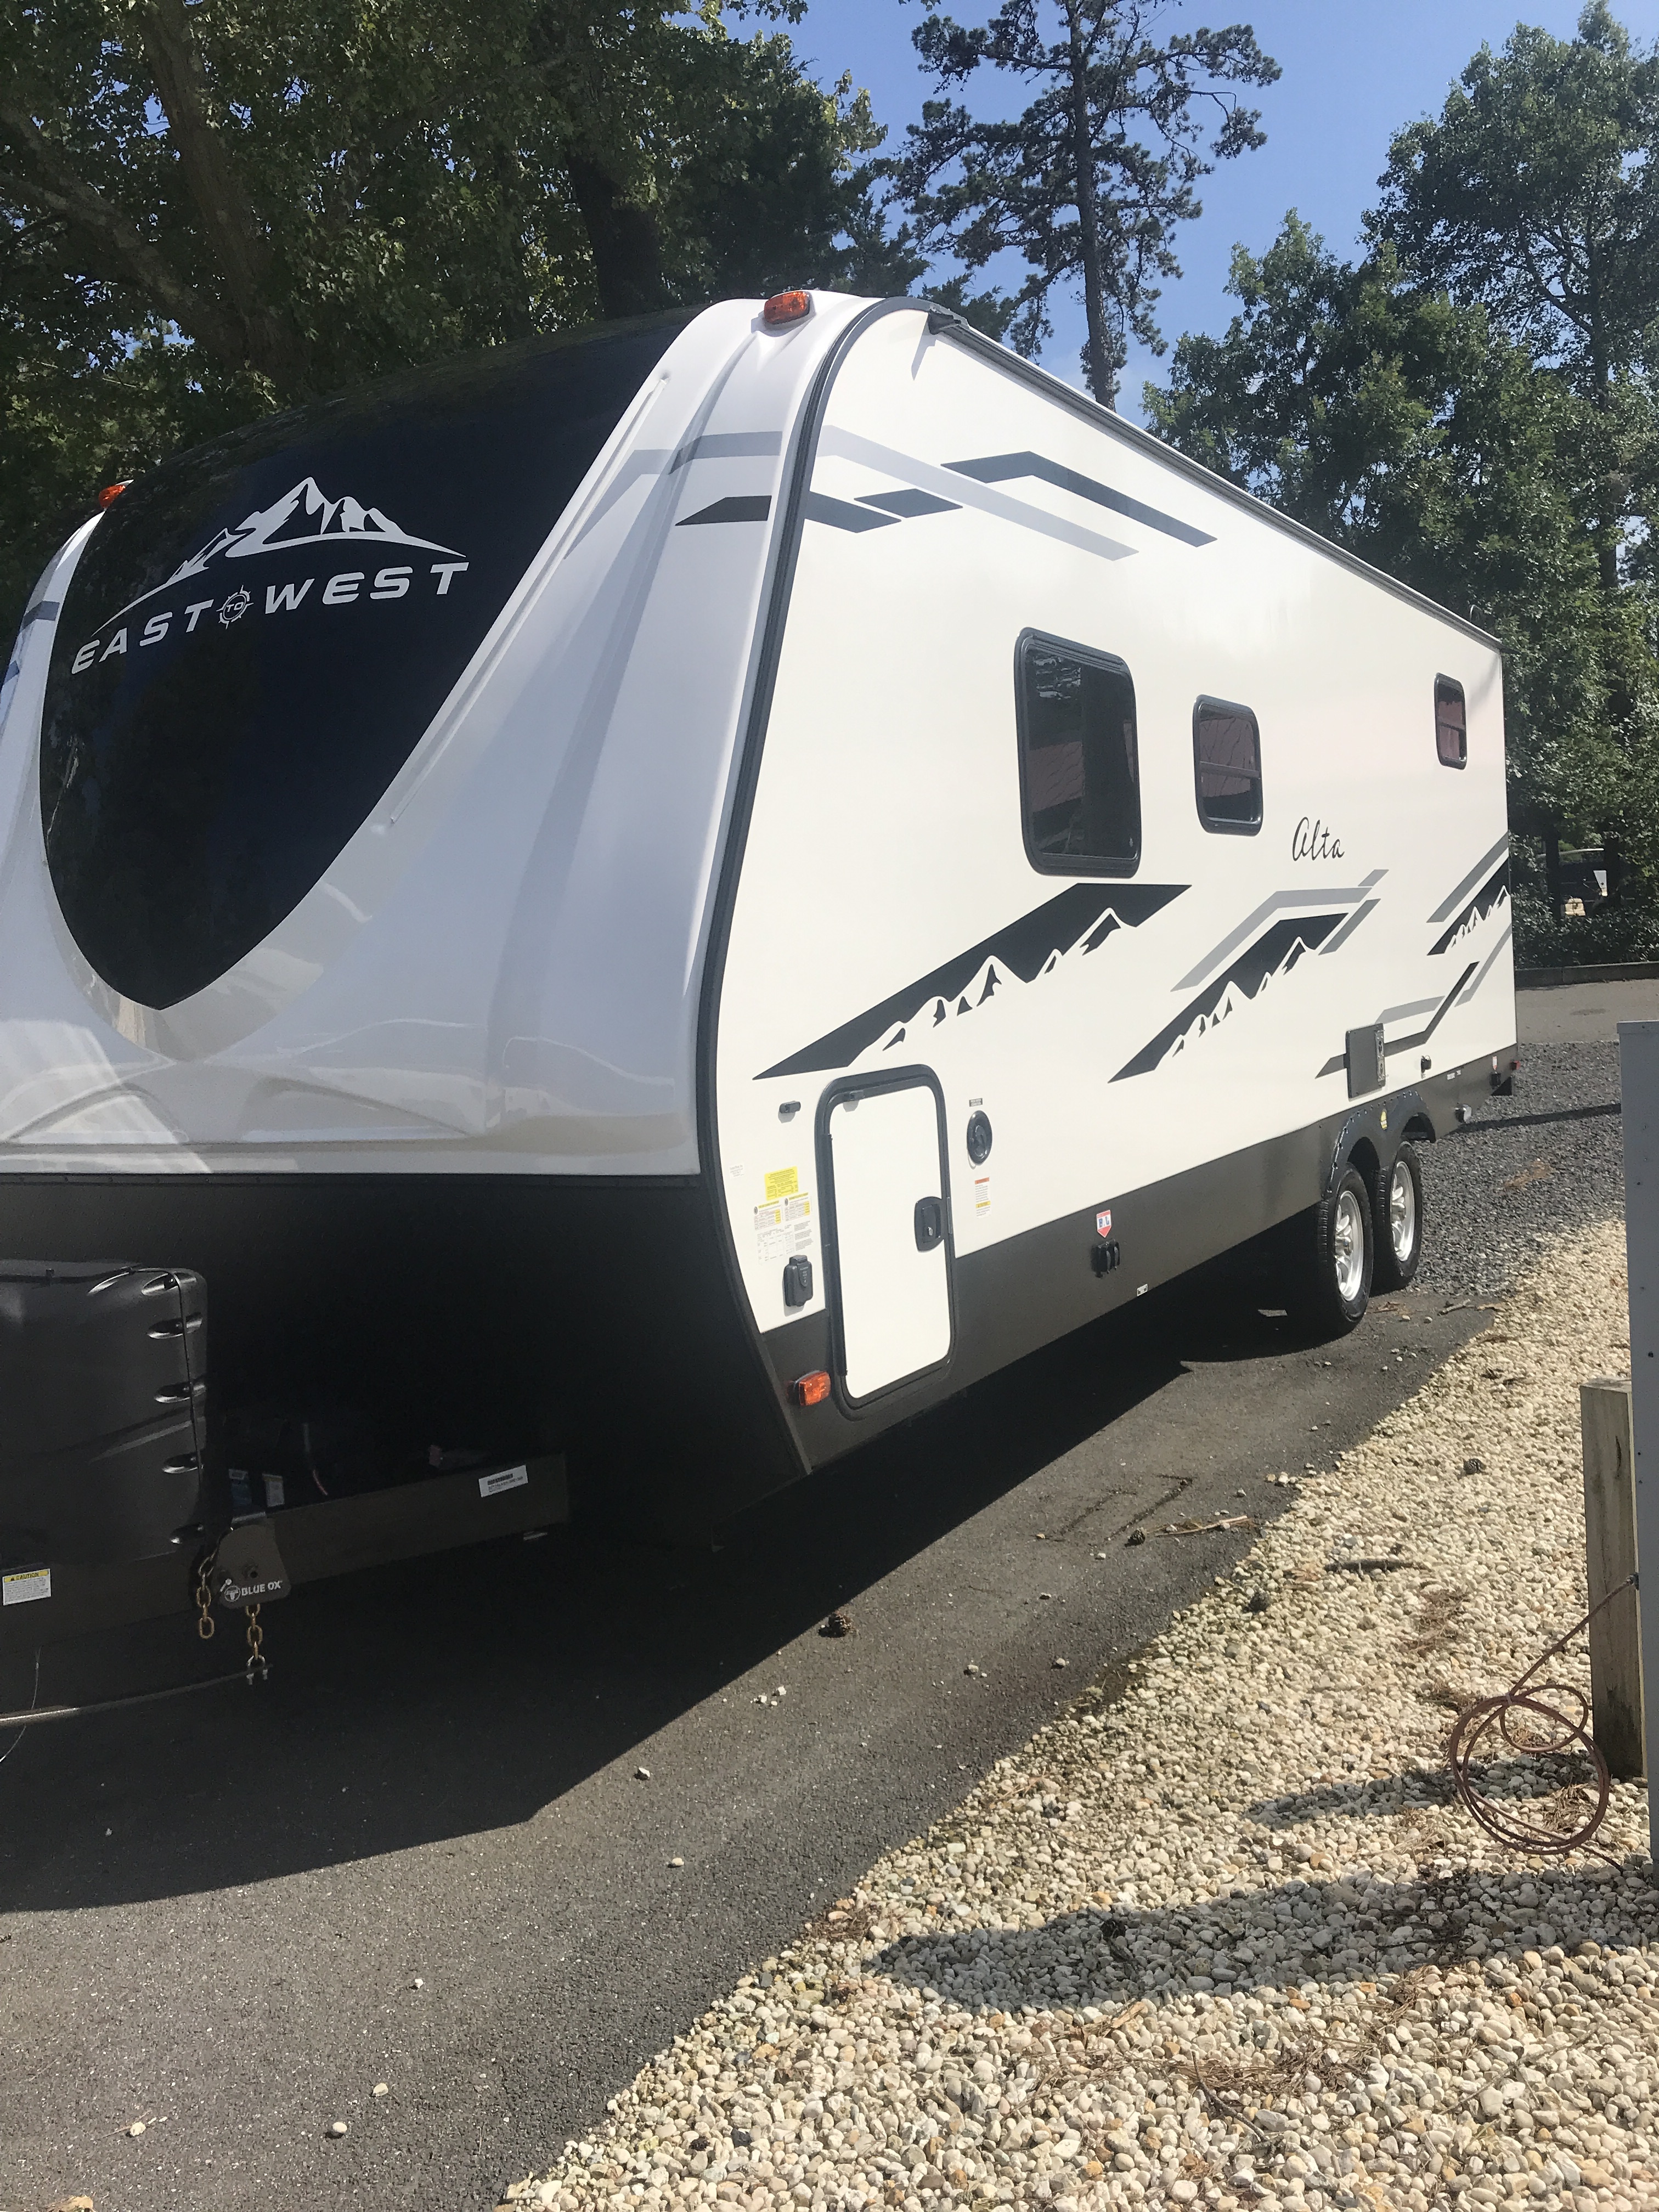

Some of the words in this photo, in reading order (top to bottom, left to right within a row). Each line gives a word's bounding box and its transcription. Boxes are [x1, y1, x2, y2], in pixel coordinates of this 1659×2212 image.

[71, 599, 213, 674] EAST
[225, 601, 245, 612] TO
[264, 562, 470, 614] WEST
[1292, 816, 1345, 861] Alta
[16, 1572, 39, 1581] CAUTION
[241, 1584, 266, 1596] BLUE
[267, 1581, 281, 1591] OX
